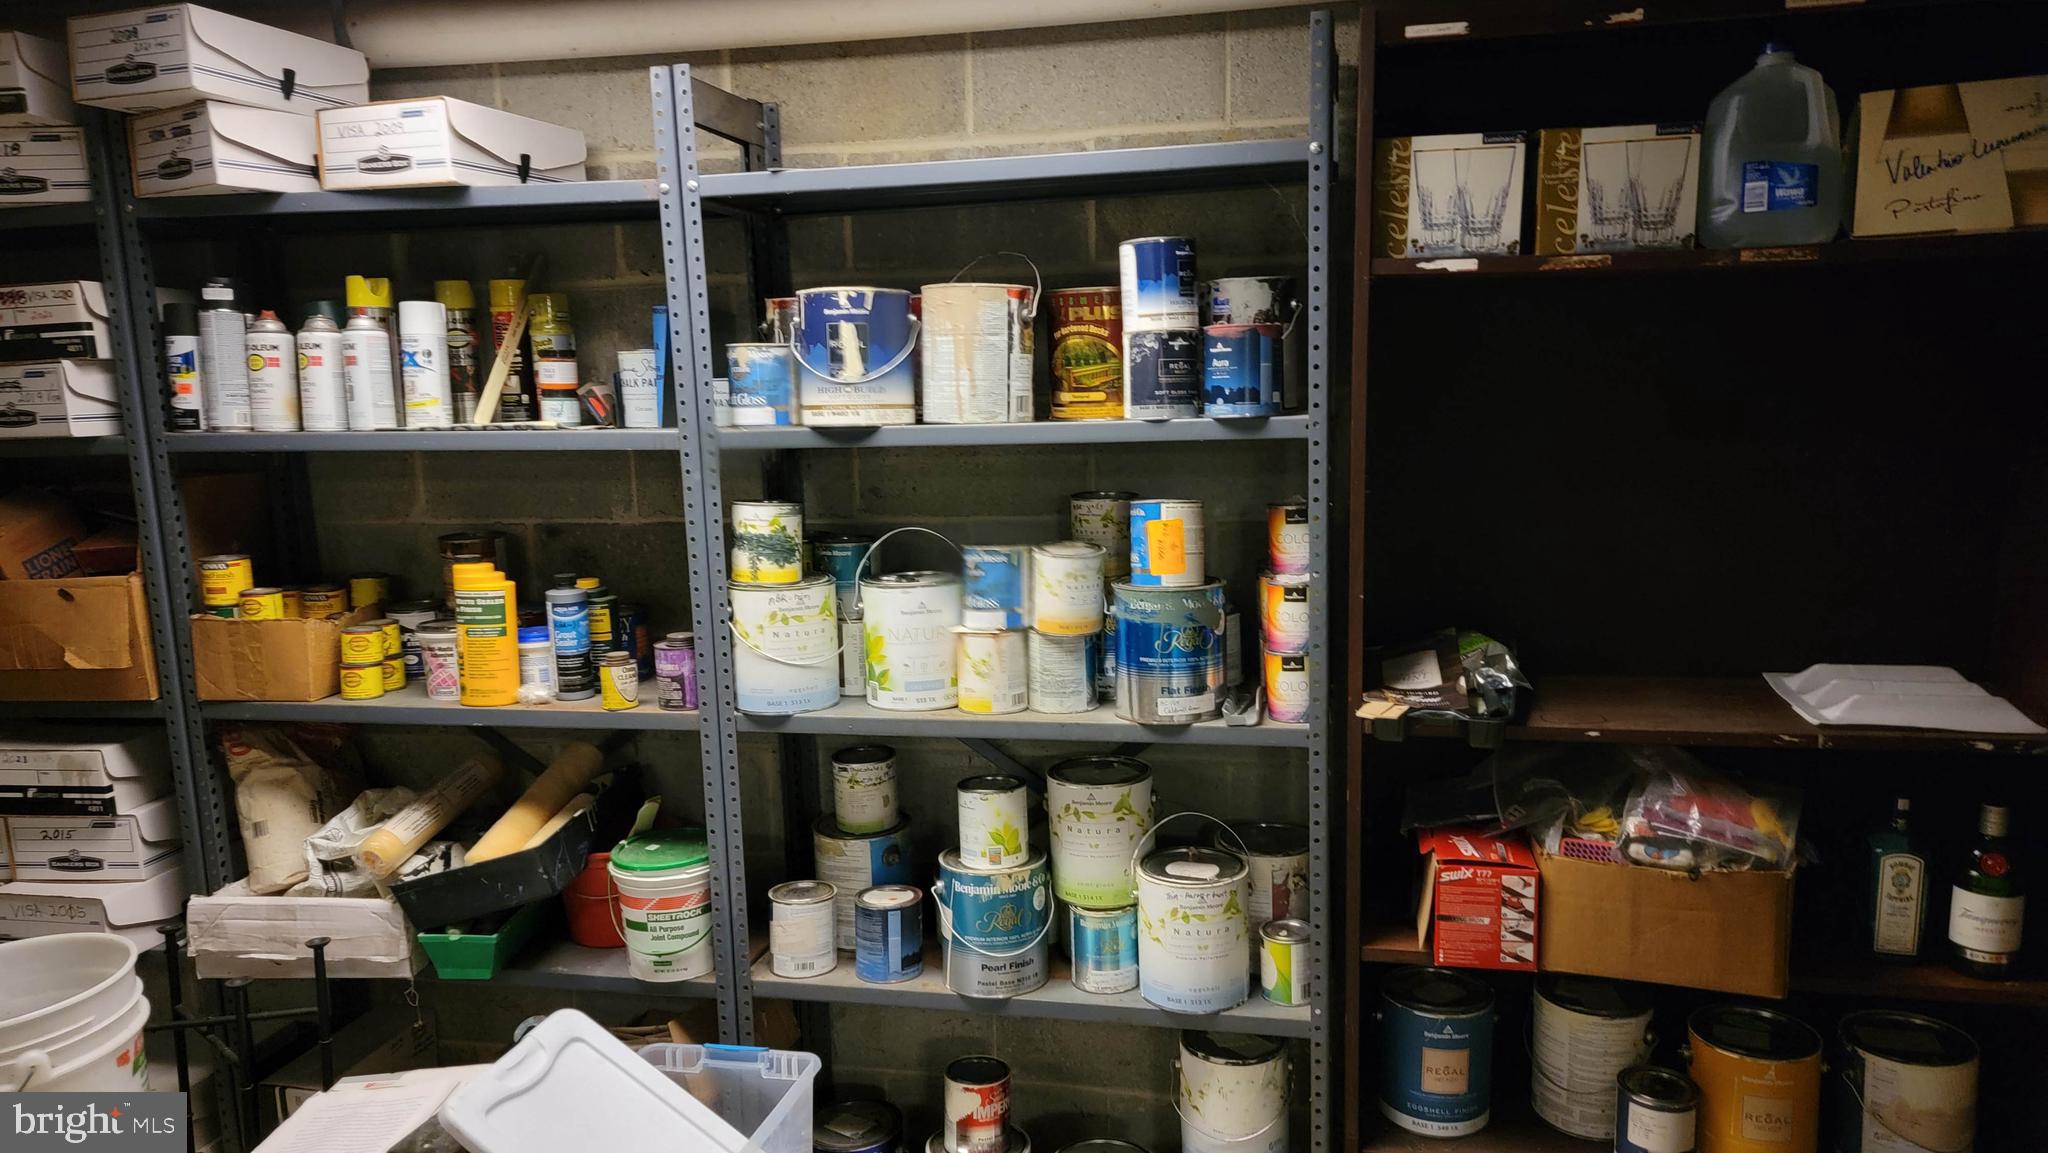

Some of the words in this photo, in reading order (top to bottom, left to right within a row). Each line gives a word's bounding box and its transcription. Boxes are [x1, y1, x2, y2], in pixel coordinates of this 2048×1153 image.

[1274, 611, 1310, 623] COLO
[771, 627, 826, 639] Natura
[888, 627, 946, 642] NATUR
[1273, 680, 1309, 693] COLO
[40, 829, 77, 841] 2015
[1067, 825, 1121, 835] Natura
[954, 880, 1001, 897] Benjamin
[648, 909, 702, 922] SHEETROCK
[650, 933, 666, 942] Joint
[667, 928, 700, 942] Compound
[659, 924, 685, 934] Purpose
[1173, 926, 1230, 937] Natura
[981, 963, 1007, 972] Pearl
[1009, 957, 1035, 971] Finish
[1426, 1065, 1466, 1076] REGAL
[973, 1097, 1010, 1121] IMPER
[1745, 1111, 1792, 1125] REGAL
